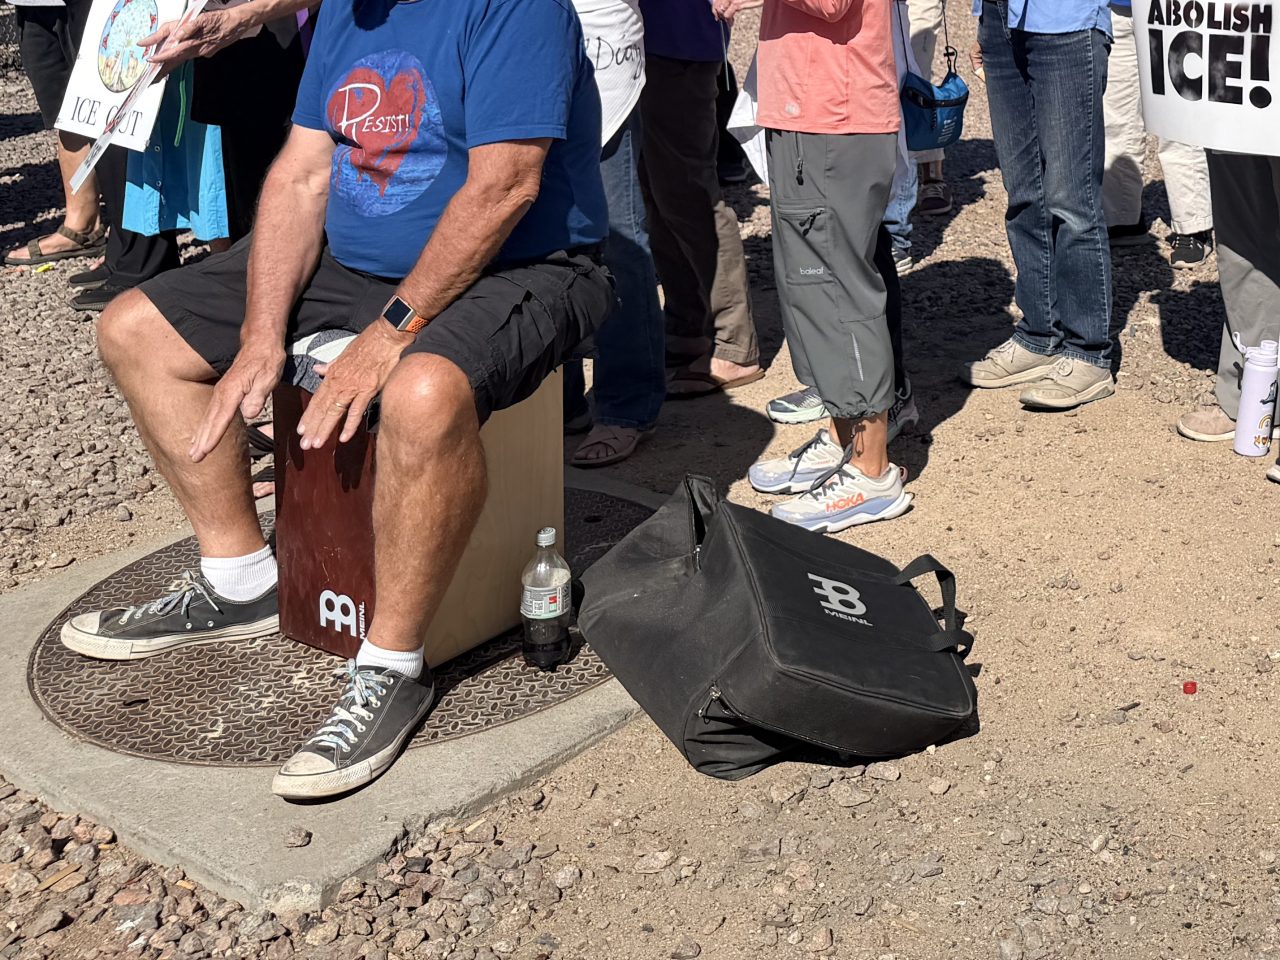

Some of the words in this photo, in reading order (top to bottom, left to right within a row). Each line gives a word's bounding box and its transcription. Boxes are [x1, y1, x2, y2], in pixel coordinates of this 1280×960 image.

[1150, 28, 1274, 110] ICE!
[70, 96, 101, 127] ICE
[825, 492, 865, 513] HOKA
[358, 601, 367, 640] MEINL
